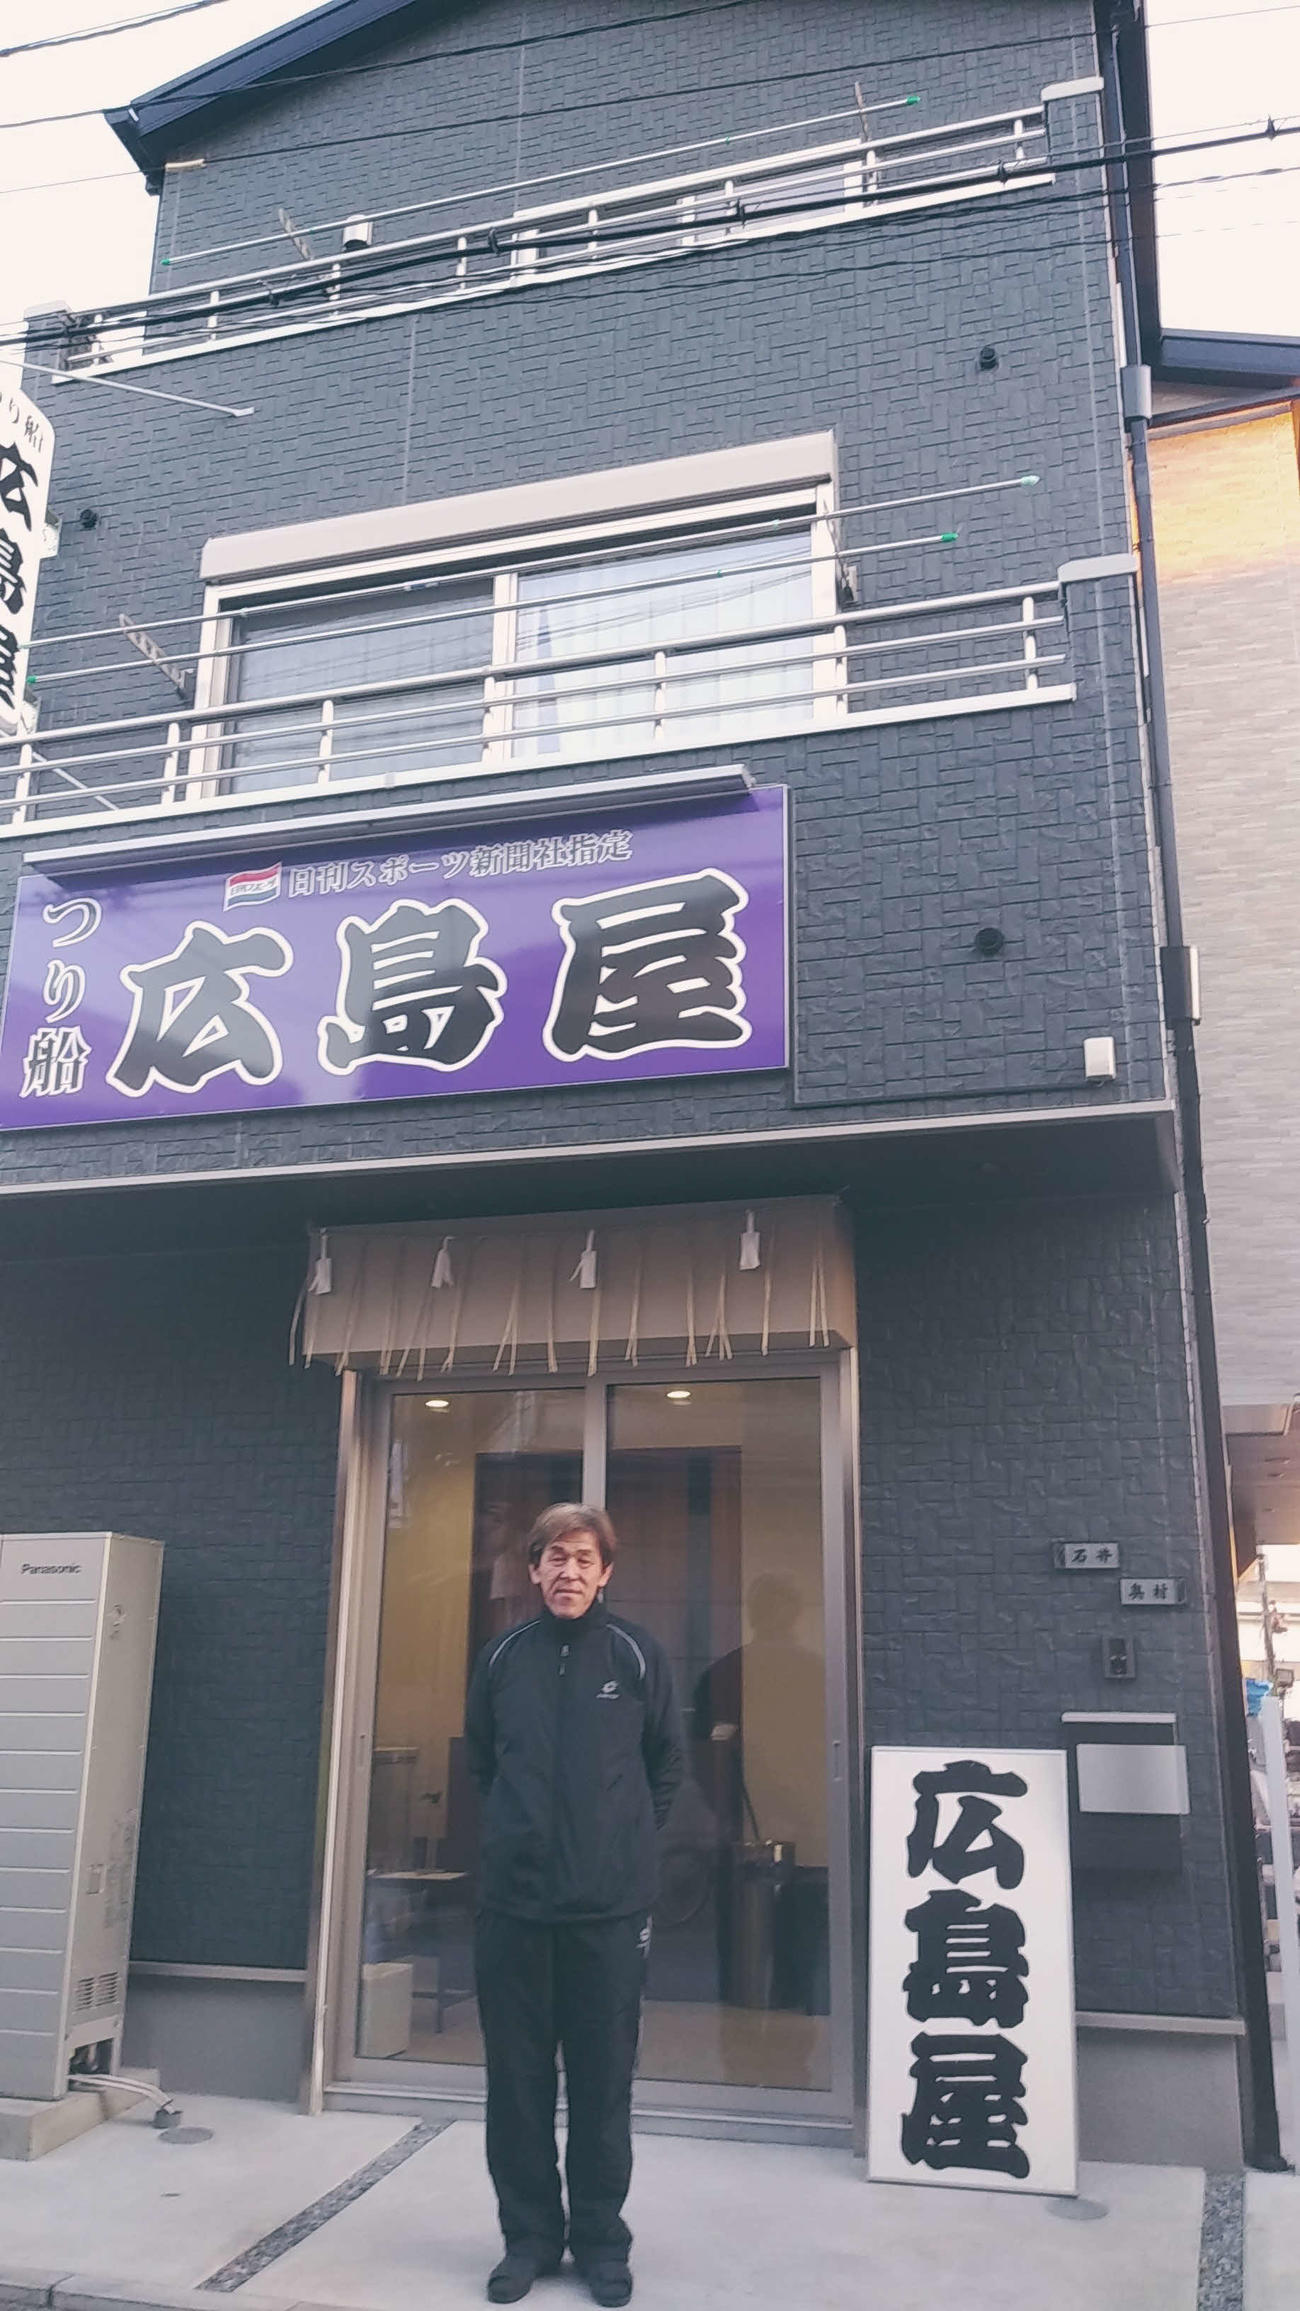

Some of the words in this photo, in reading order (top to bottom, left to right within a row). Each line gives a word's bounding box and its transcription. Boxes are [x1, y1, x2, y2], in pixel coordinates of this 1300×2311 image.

[287, 828, 634, 899] 日刊スポーツ新聞社指定
[19, 897, 103, 1099] つり船
[105, 867, 752, 1098] 広島屋
[20, 1562, 82, 1575] Panasonic
[1071, 1548, 1113, 1564] 石井
[1127, 1582, 1169, 1601] 奥村
[901, 1759, 1031, 2179] 広島屋
